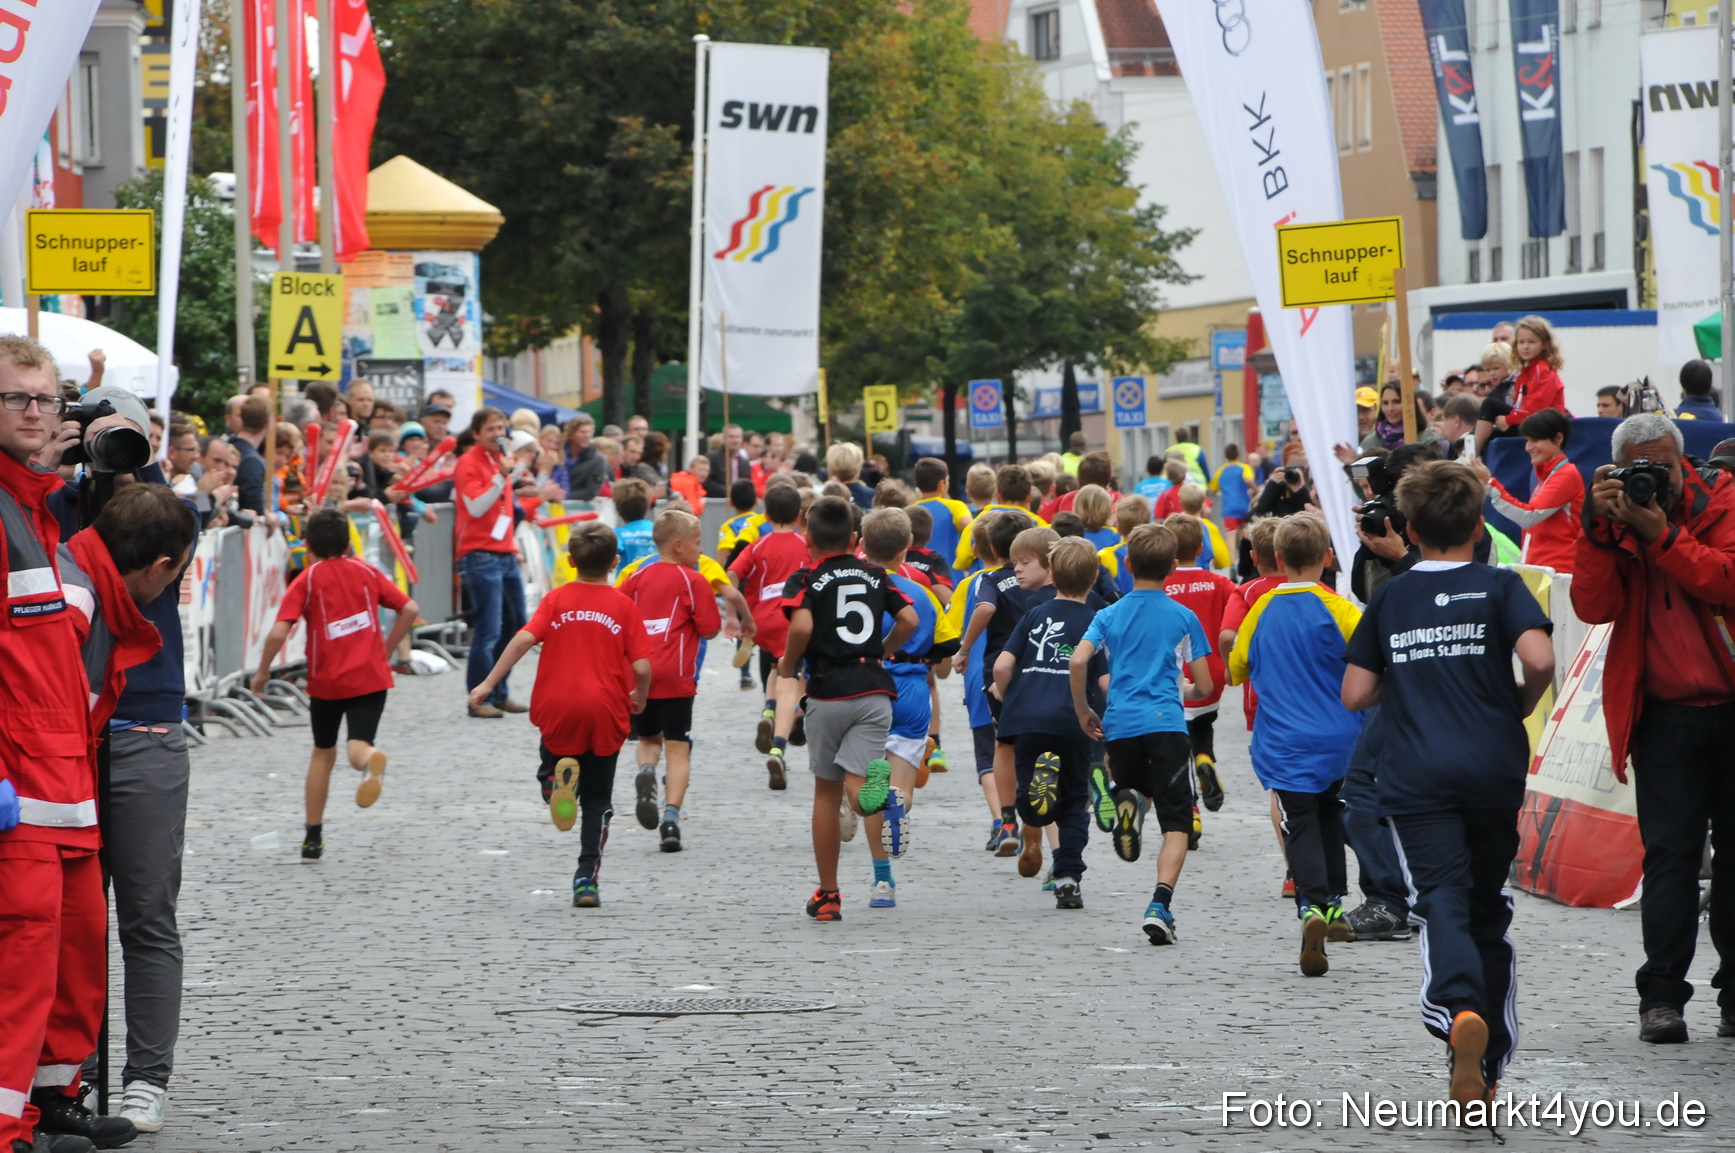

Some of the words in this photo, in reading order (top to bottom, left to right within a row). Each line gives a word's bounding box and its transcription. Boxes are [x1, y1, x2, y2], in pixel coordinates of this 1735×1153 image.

[1518, 24, 1555, 121] K&L
[719, 100, 818, 133] swn
[1242, 90, 1289, 200] BKK
[36, 234, 144, 253] Schnupper-
[73, 257, 108, 272] lauf
[1287, 245, 1393, 265] Schnupper-
[1325, 267, 1358, 284] lauf
[280, 276, 335, 296] Block
[285, 305, 325, 355] A
[873, 400, 889, 421] D
[974, 412, 999, 423] TAXI
[1116, 412, 1143, 423] TAXI
[811, 572, 834, 591] DJK
[833, 568, 880, 590] Neumarkt
[1165, 583, 1185, 596] SSV
[1188, 581, 1215, 593] JAHN
[13, 605, 41, 614] PFLIEGER
[42, 601, 62, 611] MARKUS
[835, 583, 875, 645] 5
[551, 620, 561, 630] 1.
[560, 610, 575, 624] FC
[576, 610, 622, 635] DEINING
[1389, 623, 1486, 649] GRUNDSCHULE
[1392, 651, 1407, 663] im
[1409, 648, 1435, 661] Haus
